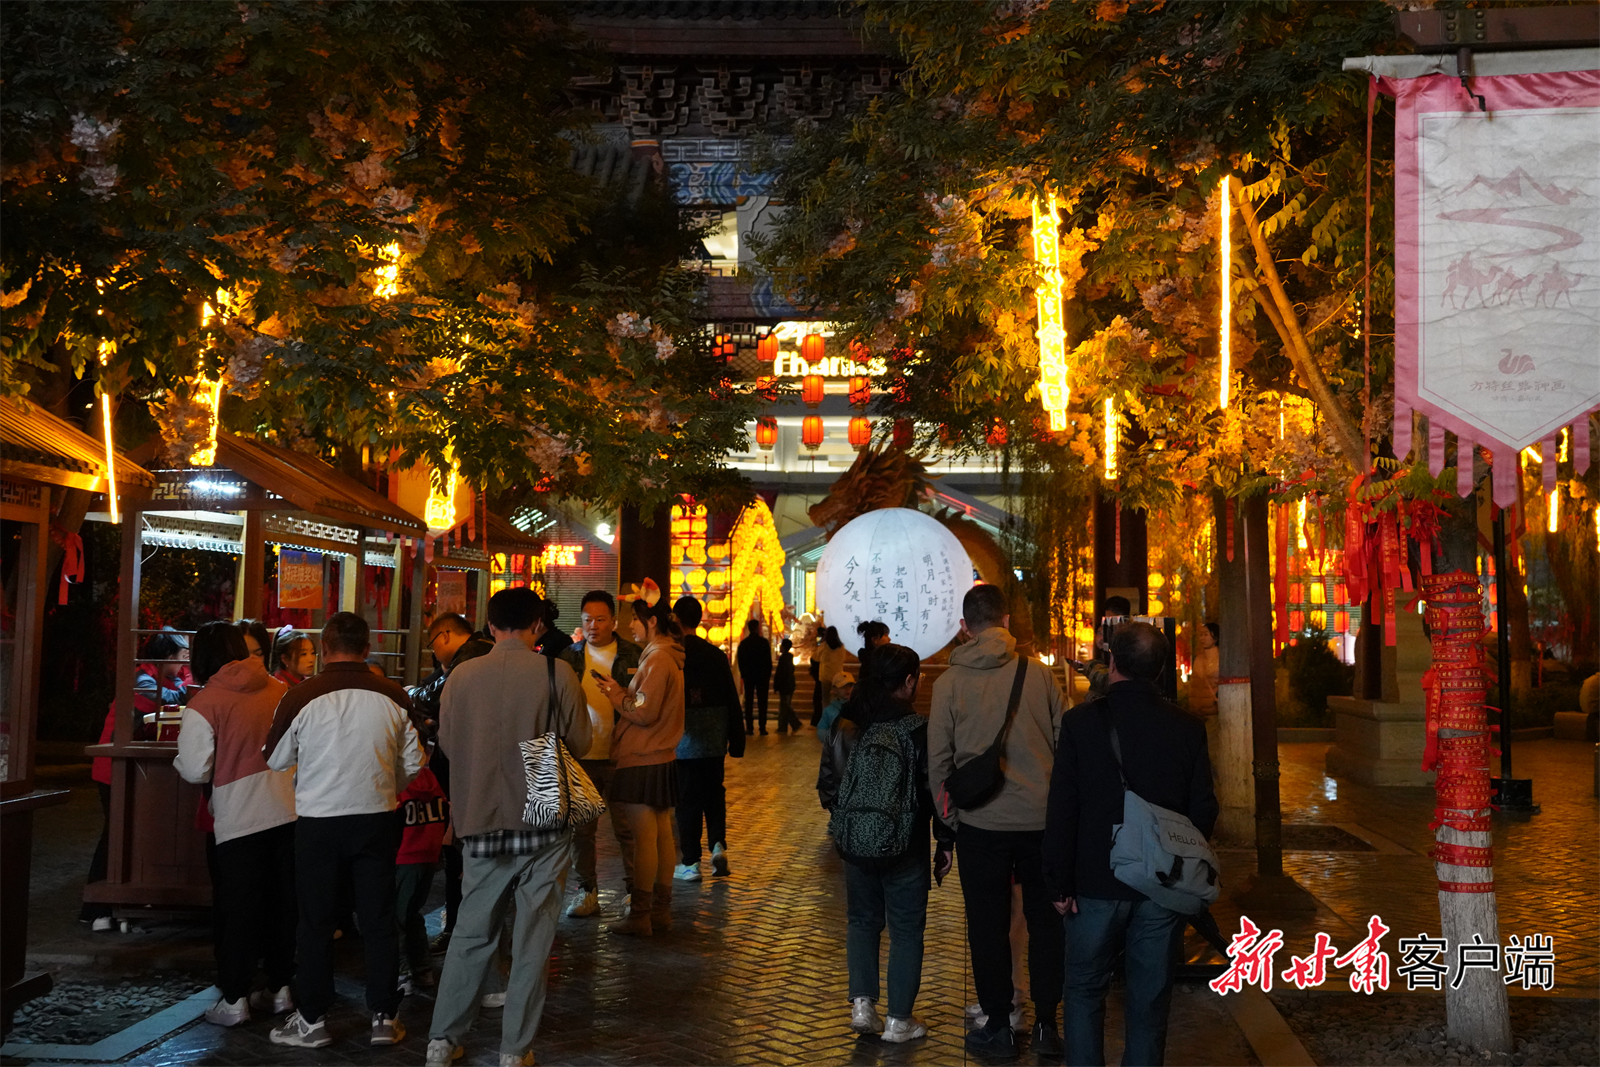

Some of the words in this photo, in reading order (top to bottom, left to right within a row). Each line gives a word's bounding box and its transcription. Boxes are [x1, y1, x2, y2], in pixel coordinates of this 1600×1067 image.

[1470, 380, 1566, 391] 方特丝路神画
[1168, 831, 1197, 845] HELLO
